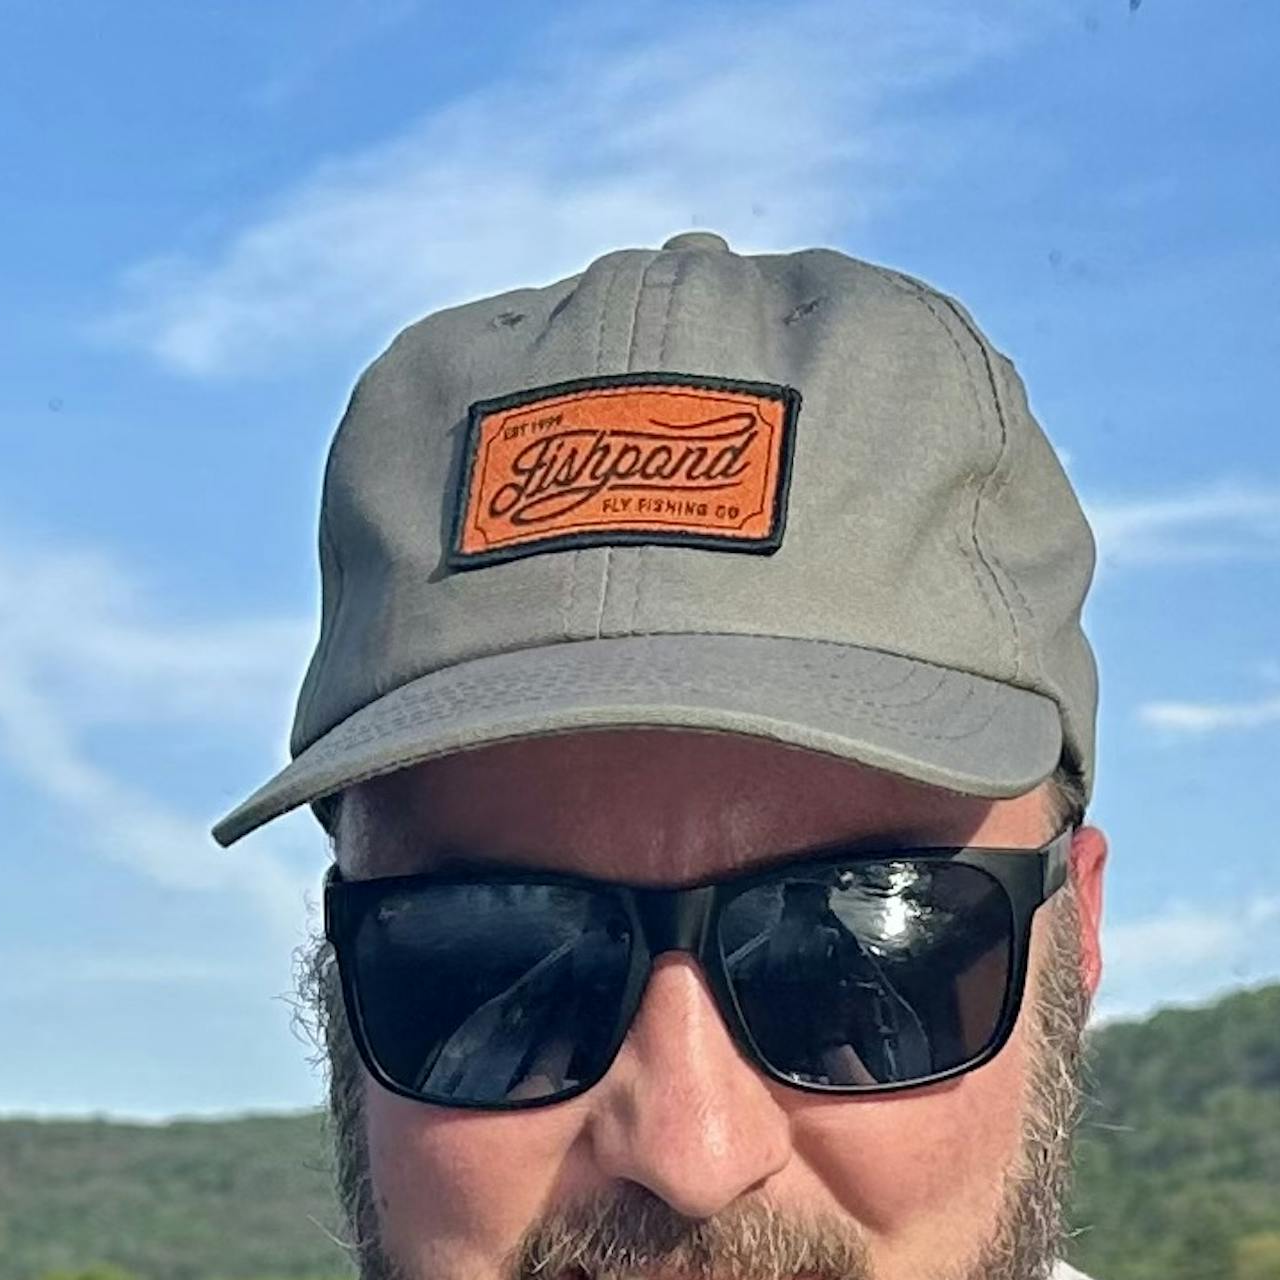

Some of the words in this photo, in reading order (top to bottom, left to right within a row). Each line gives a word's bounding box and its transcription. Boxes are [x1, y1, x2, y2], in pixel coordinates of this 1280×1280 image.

[489, 413, 758, 525] Fishpond
[602, 498, 632, 513] FLY
[637, 498, 708, 517] FISHING
